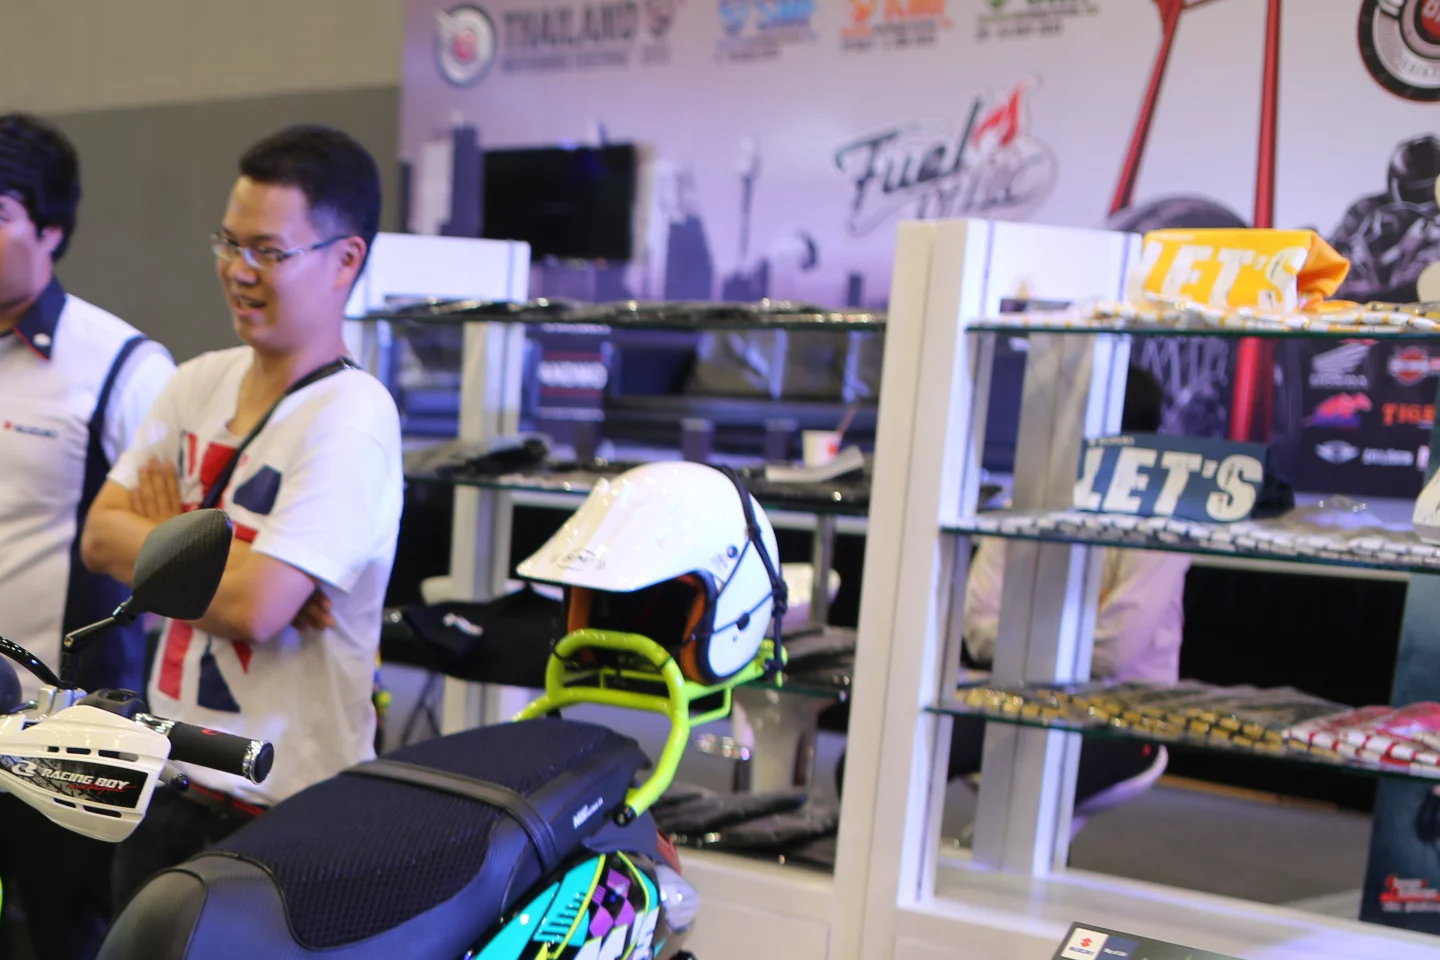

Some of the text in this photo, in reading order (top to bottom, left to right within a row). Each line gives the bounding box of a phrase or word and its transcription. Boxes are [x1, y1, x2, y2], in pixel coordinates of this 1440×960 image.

[1127, 240, 1308, 311] LET'S
[1073, 446, 1263, 522] LET'S
[40, 767, 130, 789] RACING BOY
